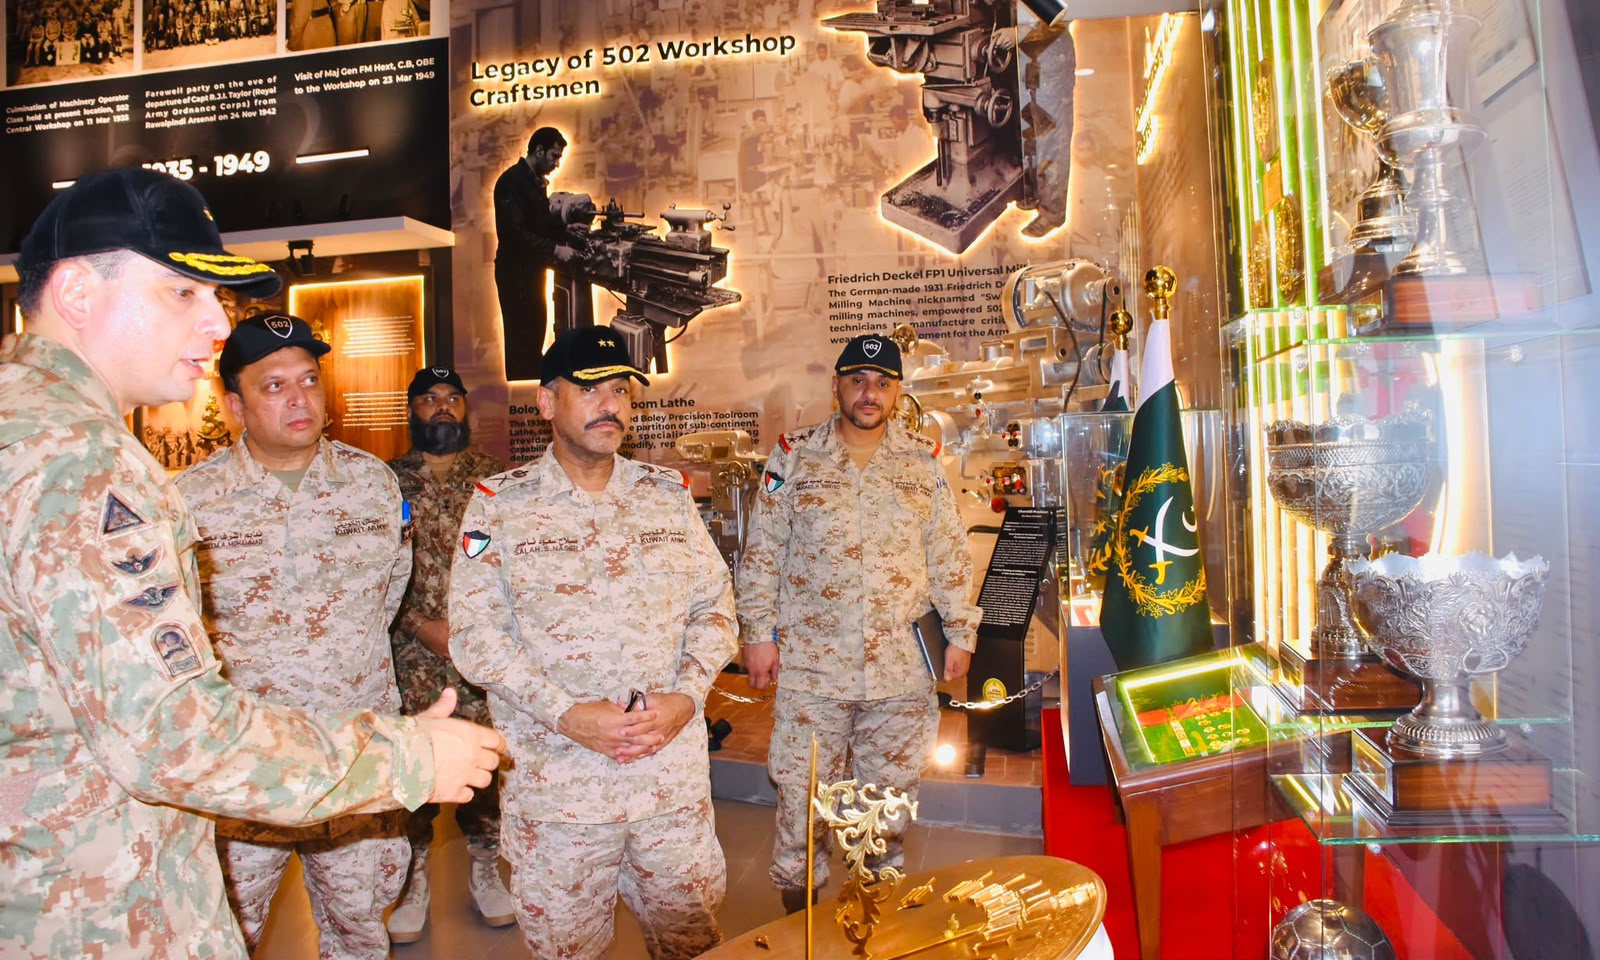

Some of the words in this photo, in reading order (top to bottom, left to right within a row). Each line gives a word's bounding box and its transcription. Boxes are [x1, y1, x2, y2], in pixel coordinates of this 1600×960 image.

[471, 53, 561, 82] Legacy
[567, 49, 594, 70] of
[602, 43, 651, 66] 502
[656, 33, 797, 62] Workshop
[294, 70, 313, 82] Visit
[314, 69, 323, 79] of
[324, 68, 340, 78] Maj
[341, 67, 358, 76] Gen
[359, 65, 373, 73] FM
[416, 57, 435, 66] OBE
[145, 86, 183, 98] Farewell
[186, 84, 211, 93] party
[228, 80, 244, 88] the
[247, 78, 264, 86] eve
[267, 75, 277, 83] of
[294, 86, 304, 95] to
[306, 85, 320, 94] the
[323, 79, 366, 91] Workshop
[368, 78, 380, 86] on
[382, 76, 393, 84] 23
[396, 74, 413, 83] Mar
[415, 71, 435, 80] 1949
[60, 97, 95, 108] Machinery
[98, 94, 130, 104] Operator
[145, 97, 182, 108] departure
[182, 96, 191, 104] of
[191, 94, 209, 103] Capt
[228, 89, 252, 100] Taylor
[252, 86, 277, 97] (Royal
[469, 78, 601, 108] Craftsmen
[44, 112, 52, 120] at
[54, 109, 81, 120] present
[116, 104, 130, 112] 502
[145, 109, 168, 118] Army
[172, 104, 216, 115] Ordnance
[220, 100, 250, 110] Corps)
[254, 98, 277, 106] from
[6, 125, 32, 134] Central
[34, 120, 72, 132] Workshop
[96, 116, 110, 124] Mar
[145, 116, 187, 129] Rawalpindi
[188, 114, 217, 124] Arsenal
[241, 110, 257, 118] Nov
[142, 158, 194, 181] 35
[213, 150, 270, 177] 1949
[828, 272, 880, 284] Friedrich
[882, 270, 923, 281] Deckel
[926, 269, 945, 279] FP1
[948, 265, 1003, 277] Universal
[828, 289, 846, 298] The
[850, 285, 920, 296] German-made
[924, 284, 944, 292] 1931
[947, 281, 992, 291] Friedrich
[829, 300, 863, 309] Milling
[868, 297, 912, 307] Machine
[917, 294, 975, 305] nicknamed
[829, 311, 863, 321] milling
[867, 308, 919, 319] machines,
[922, 305, 983, 317] empowered
[829, 321, 888, 332] technicians
[909, 318, 975, 329] manufacture
[953, 330, 967, 338] for
[969, 329, 986, 337] the
[508, 404, 540, 416] Boley
[660, 398, 695, 408] Lathe
[636, 422, 676, 432] partition
[678, 421, 688, 429] of
[690, 419, 759, 429] sub-continent,
[641, 414, 667, 423] Boley
[669, 411, 712, 421] Precision
[714, 411, 759, 419] Toolroom
[621, 441, 656, 450] modify,
